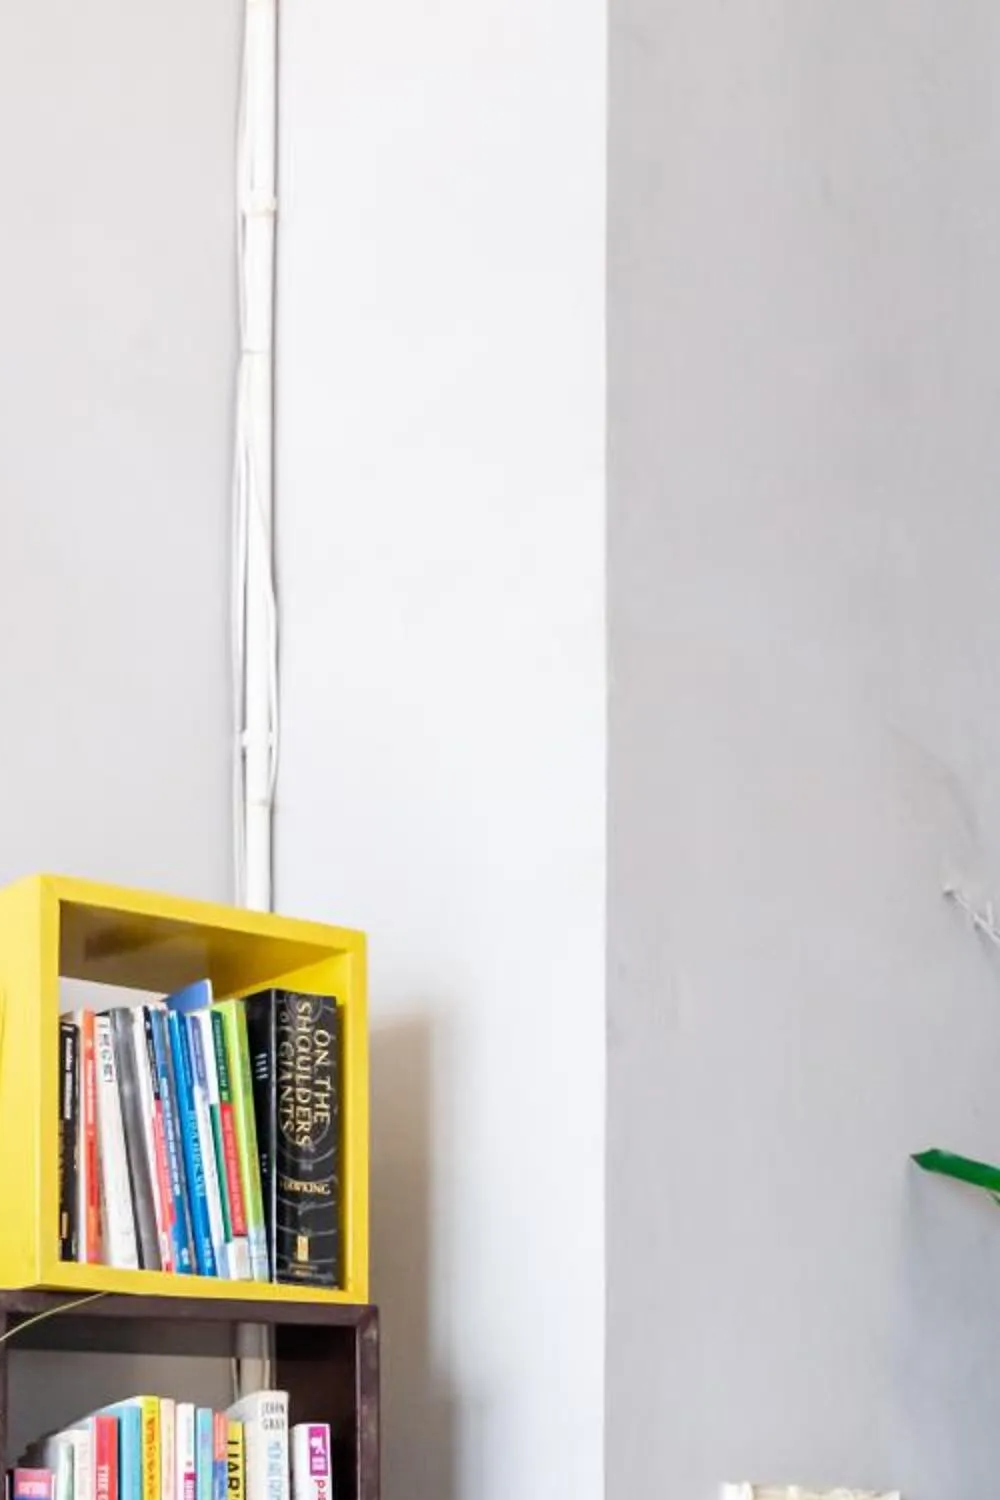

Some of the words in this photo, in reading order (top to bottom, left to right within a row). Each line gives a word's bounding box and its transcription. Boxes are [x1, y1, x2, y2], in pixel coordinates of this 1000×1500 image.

[295, 1001, 313, 1147] SHOULDERS
[313, 1029, 331, 1066] ON
[279, 1041, 295, 1132] GIANTS
[313, 1075, 331, 1123] THE
